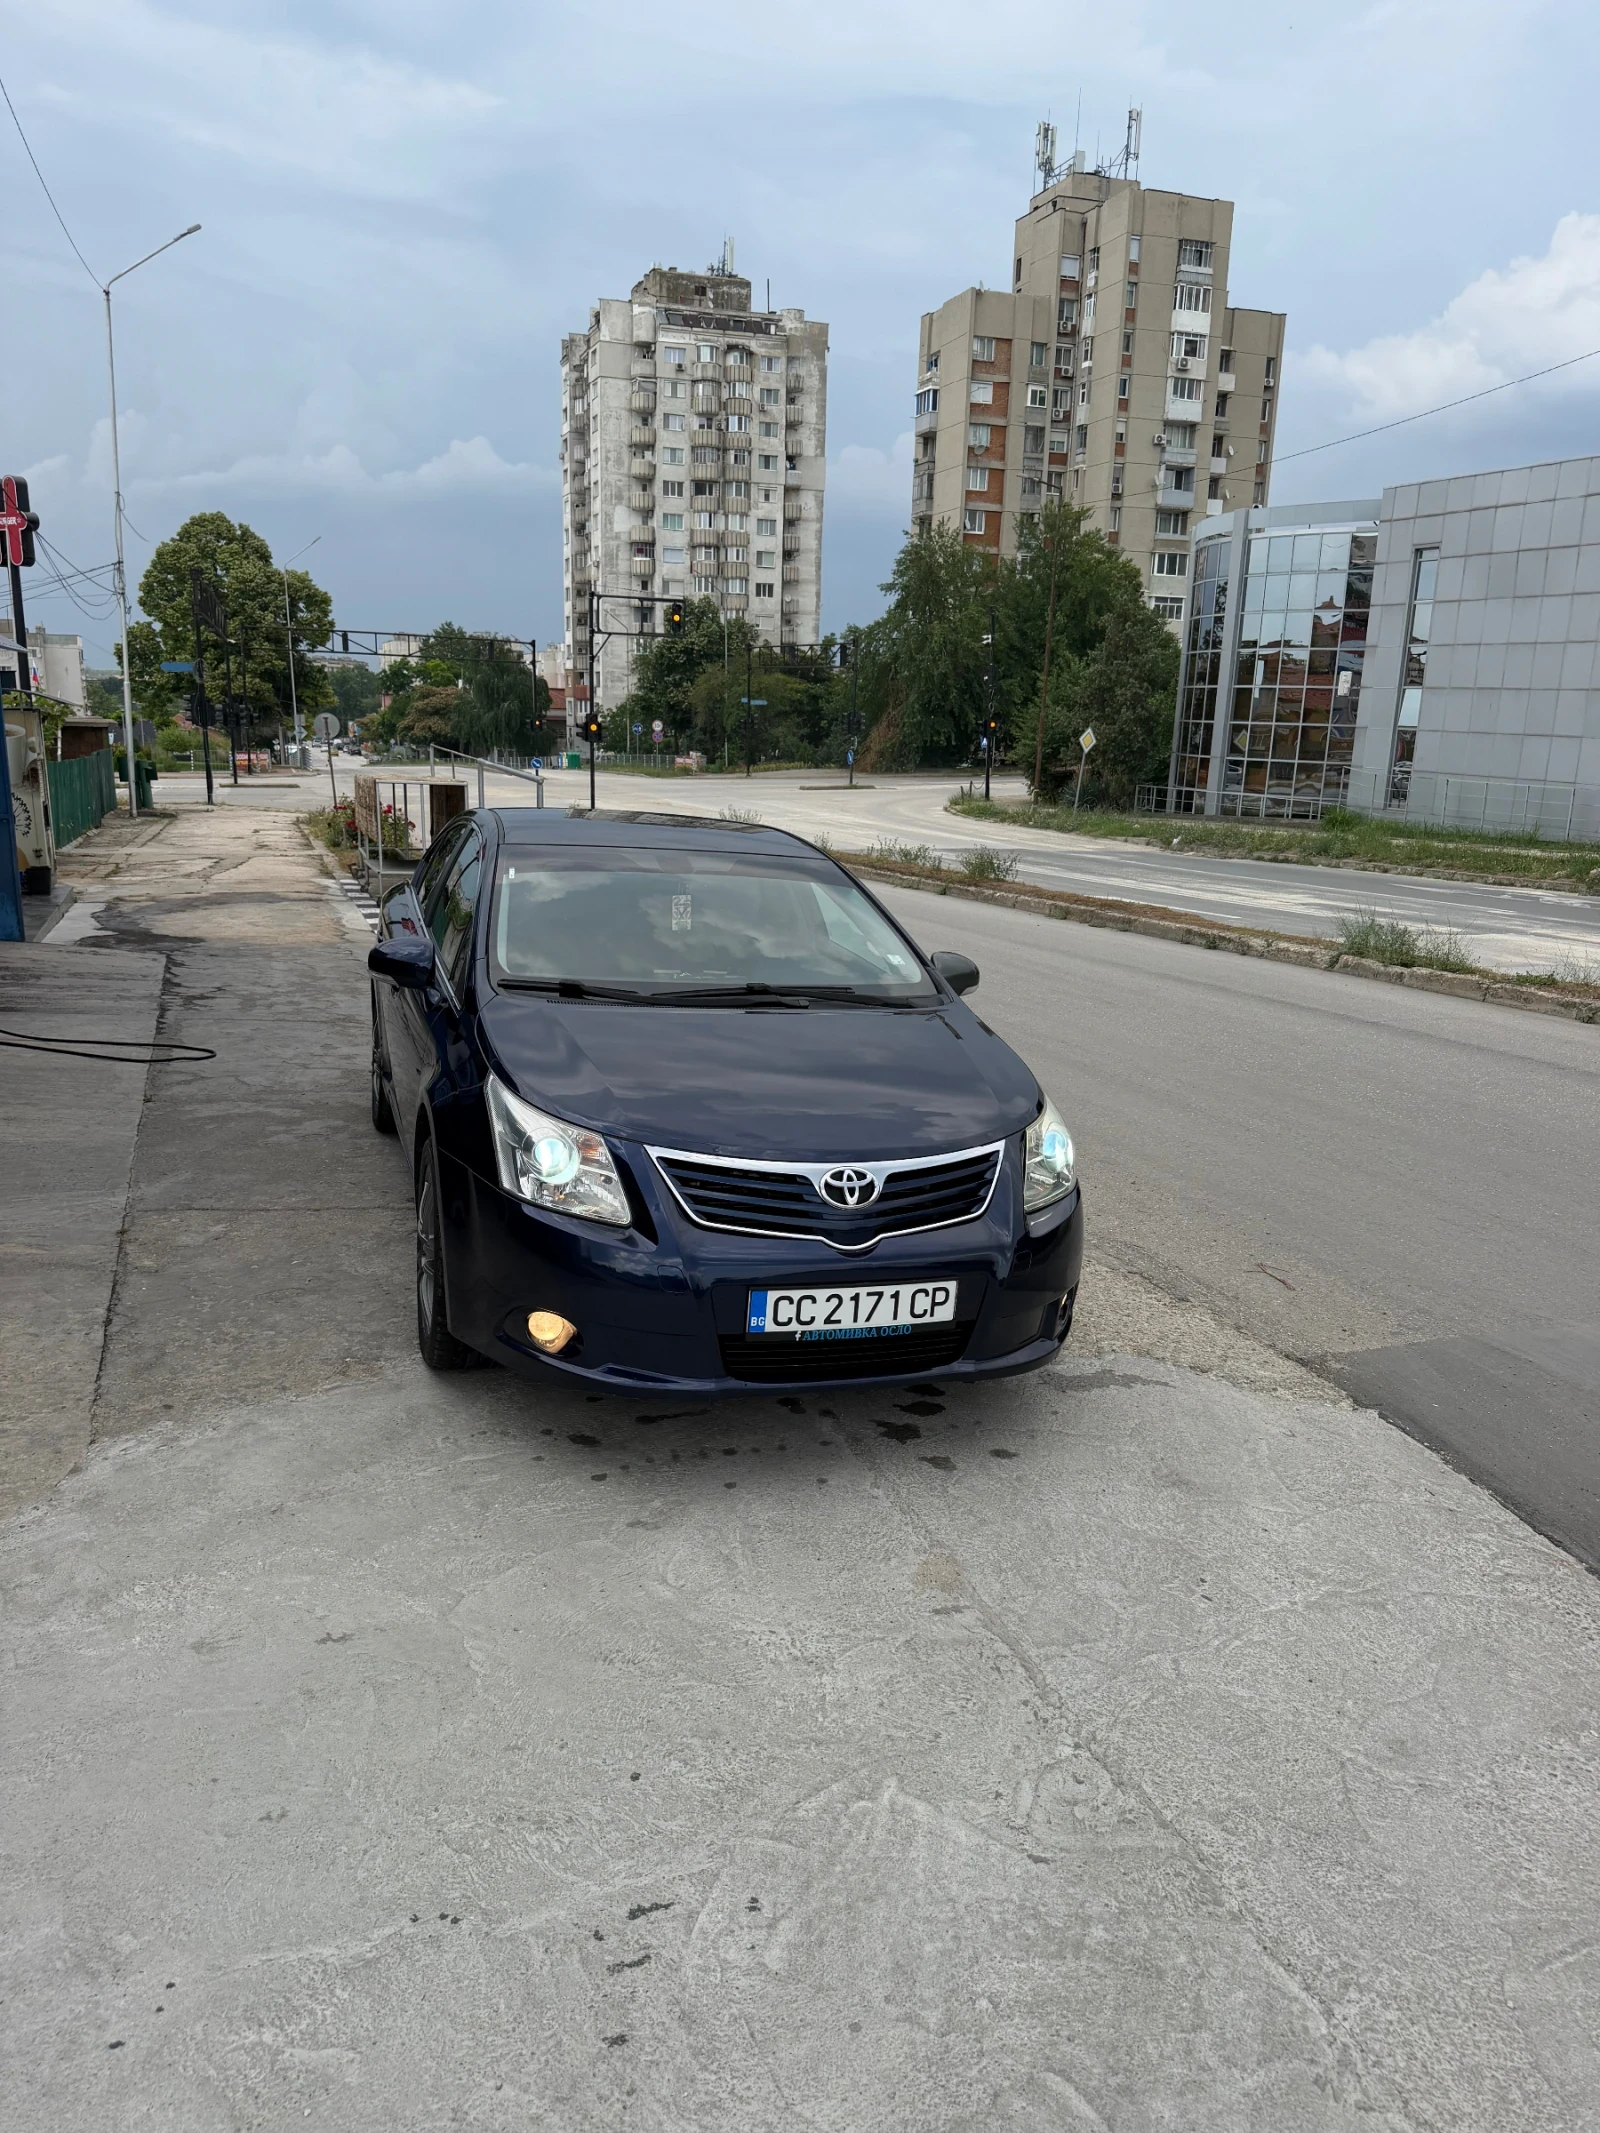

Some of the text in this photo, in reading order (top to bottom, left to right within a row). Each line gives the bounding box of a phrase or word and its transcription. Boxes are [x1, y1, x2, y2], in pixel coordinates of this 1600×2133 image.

[823, 1290, 901, 1325] 2171
[750, 1316, 765, 1327] BG
[802, 1327, 878, 1341] АВТОМИВКА
[880, 1324, 912, 1337] ОСЛО
